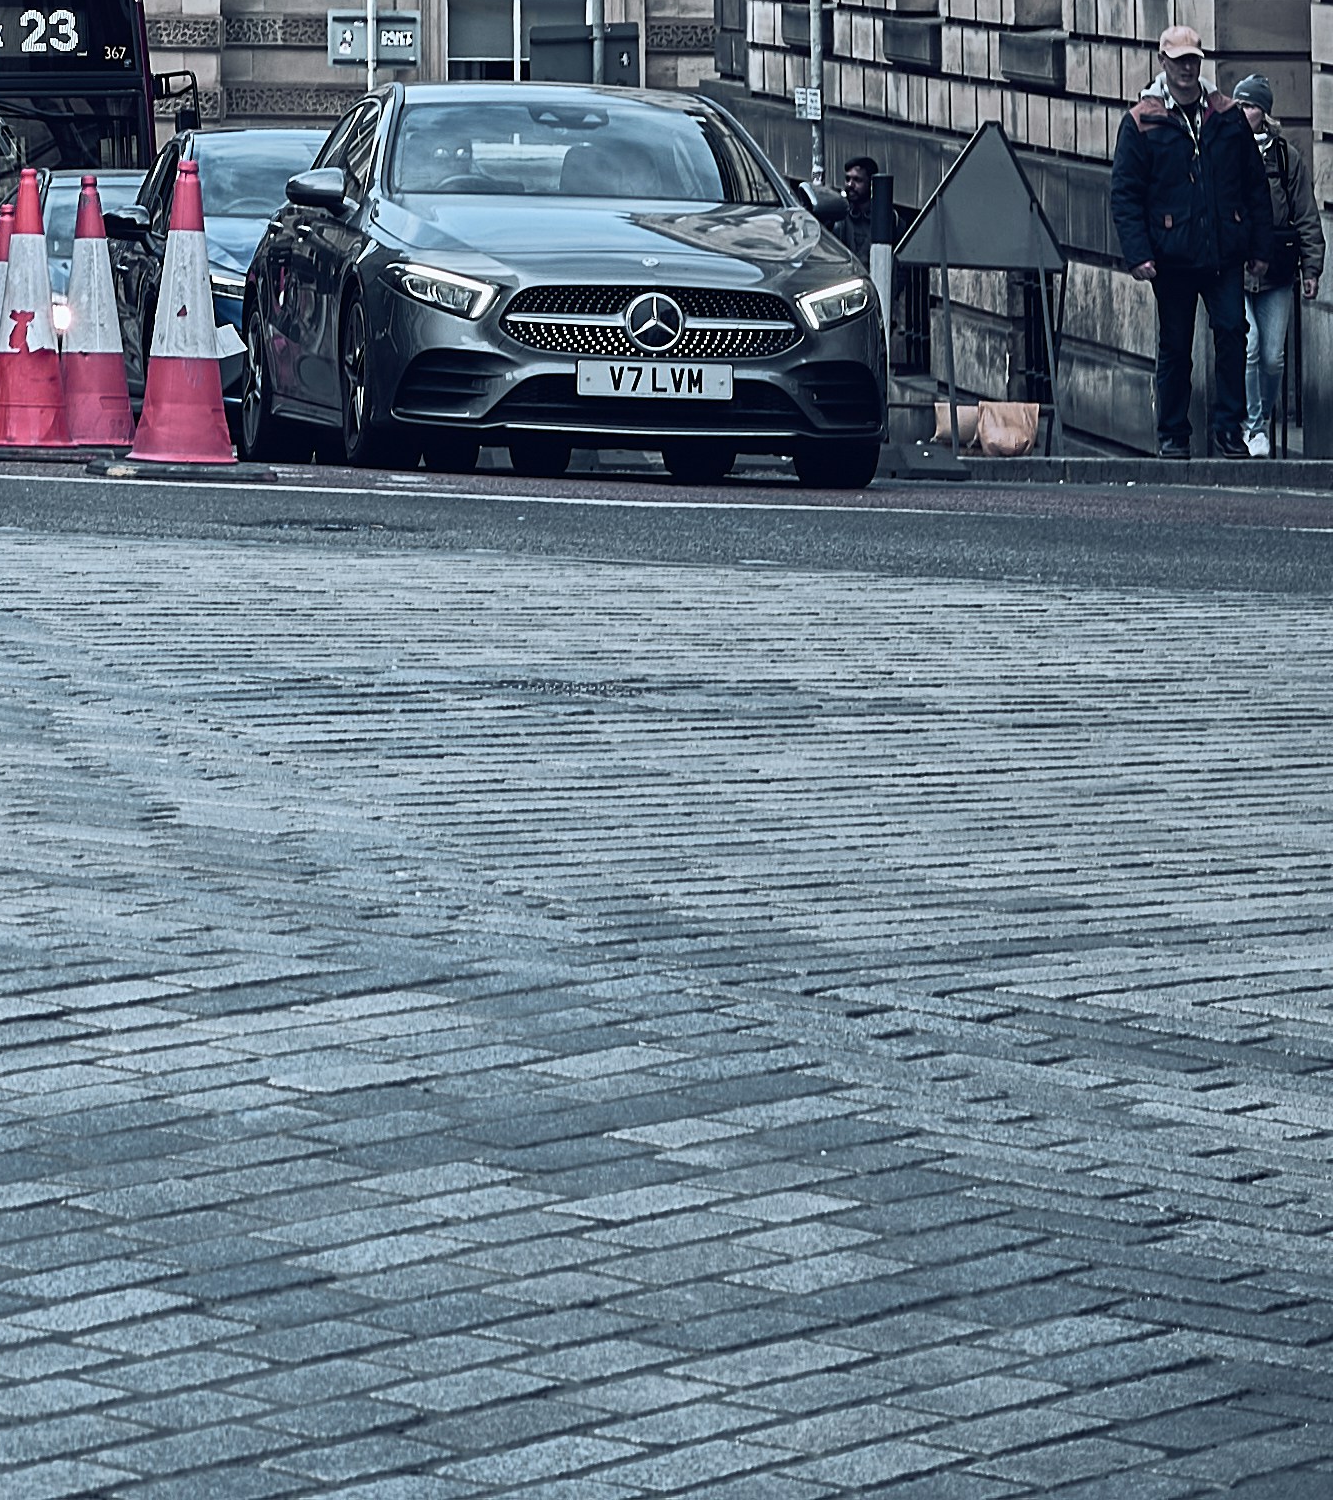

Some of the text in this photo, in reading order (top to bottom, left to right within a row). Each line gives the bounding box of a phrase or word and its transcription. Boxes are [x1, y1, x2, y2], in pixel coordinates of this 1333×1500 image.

[19, 9, 79, 53] 23
[103, 46, 127, 60] 367
[609, 365, 704, 394] V7 LVM
